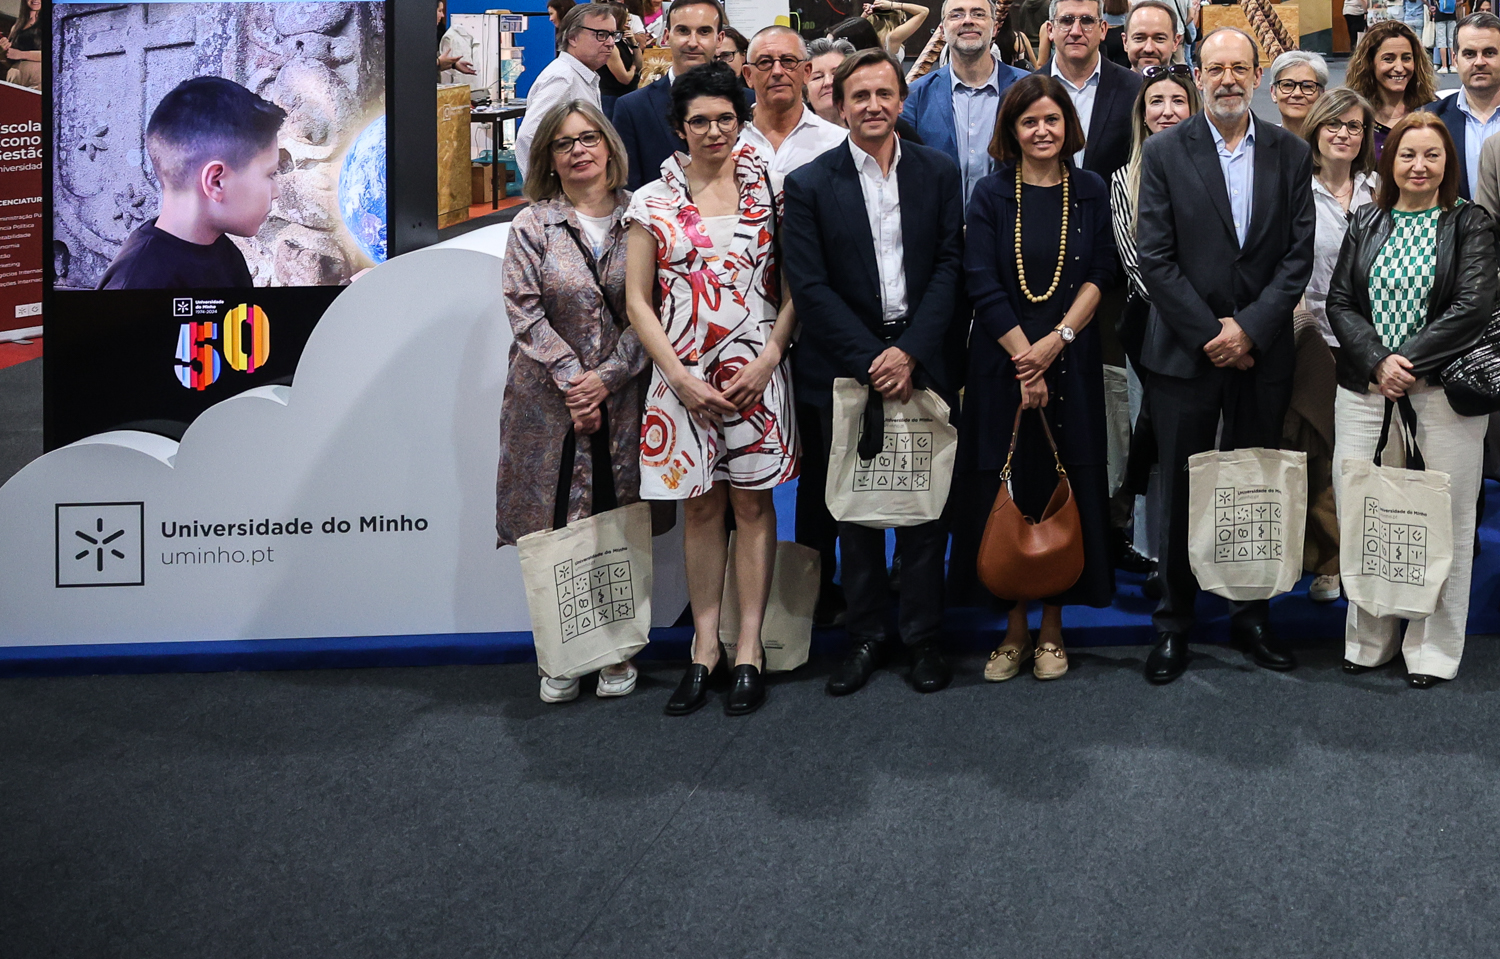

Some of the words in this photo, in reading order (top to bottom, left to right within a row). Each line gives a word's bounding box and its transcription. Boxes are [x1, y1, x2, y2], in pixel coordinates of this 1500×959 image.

[174, 303, 270, 391] 50
[161, 518, 313, 538] Universidade
[321, 516, 351, 533] do
[359, 514, 429, 533] Minho
[161, 546, 275, 566] uminho.pt
